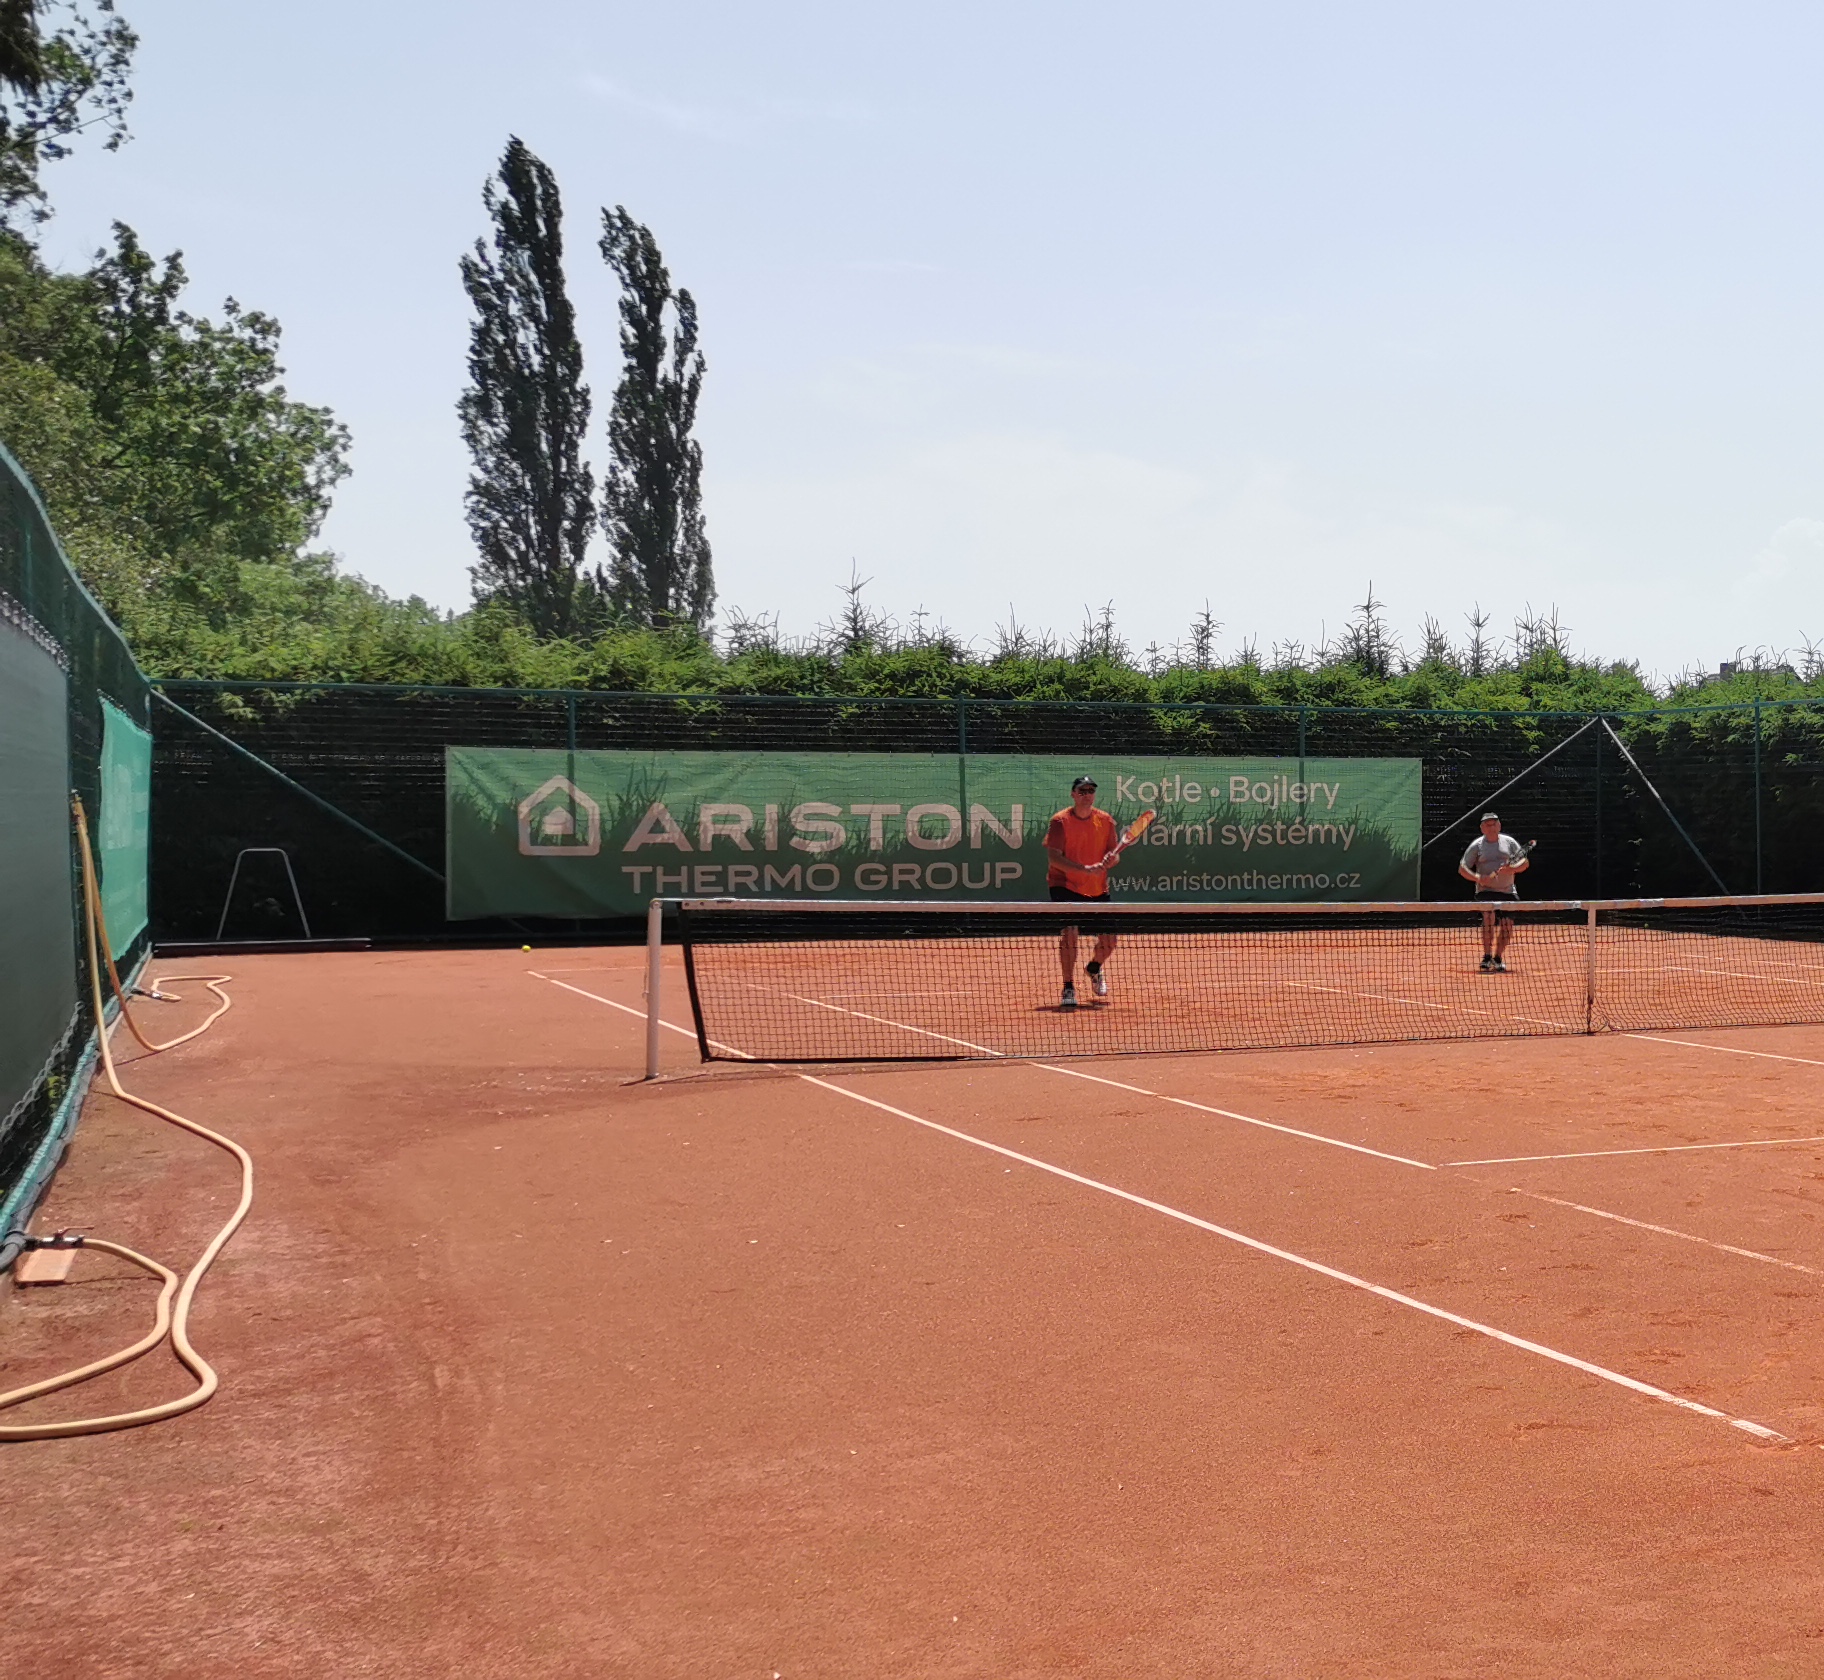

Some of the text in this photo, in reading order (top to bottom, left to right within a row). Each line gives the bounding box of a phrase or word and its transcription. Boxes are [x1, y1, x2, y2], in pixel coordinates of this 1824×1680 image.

[1116, 774, 1340, 810] Kotle Bojlery
[622, 802, 1024, 852] ARISTON
[1221, 816, 1356, 851] systémy
[621, 861, 1024, 894] THERMO GROUP
[1106, 869, 1361, 892] ww.aristonthermo.cz
